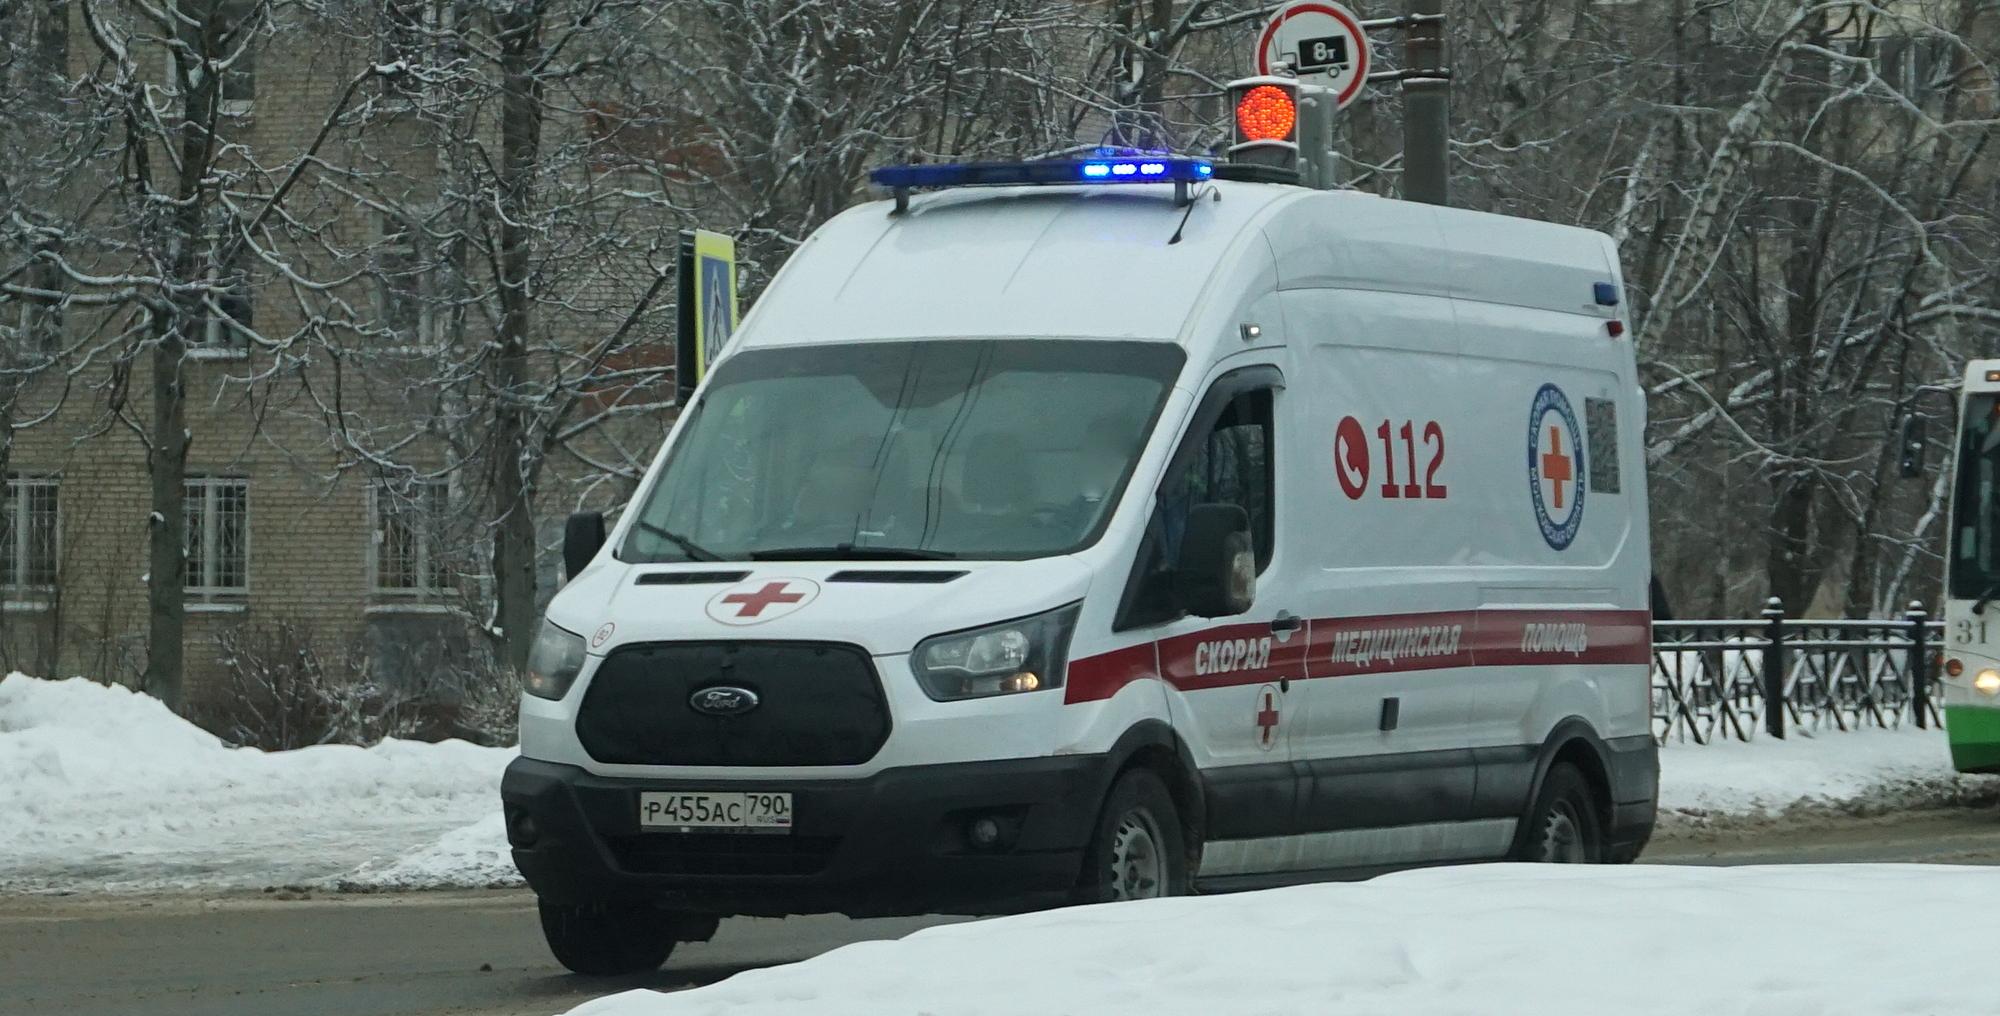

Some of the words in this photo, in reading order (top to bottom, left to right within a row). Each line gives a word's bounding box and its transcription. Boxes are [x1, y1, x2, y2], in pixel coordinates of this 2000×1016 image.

[1377, 418, 1447, 499] 112
[1194, 636, 1272, 676] СКОРАЯ
[1331, 624, 1462, 668] МЕДИЦИНСКАЯ
[1521, 623, 1588, 658] ПОМОЩЬ
[703, 691, 741, 708] Ford
[747, 795, 785, 816] 790
